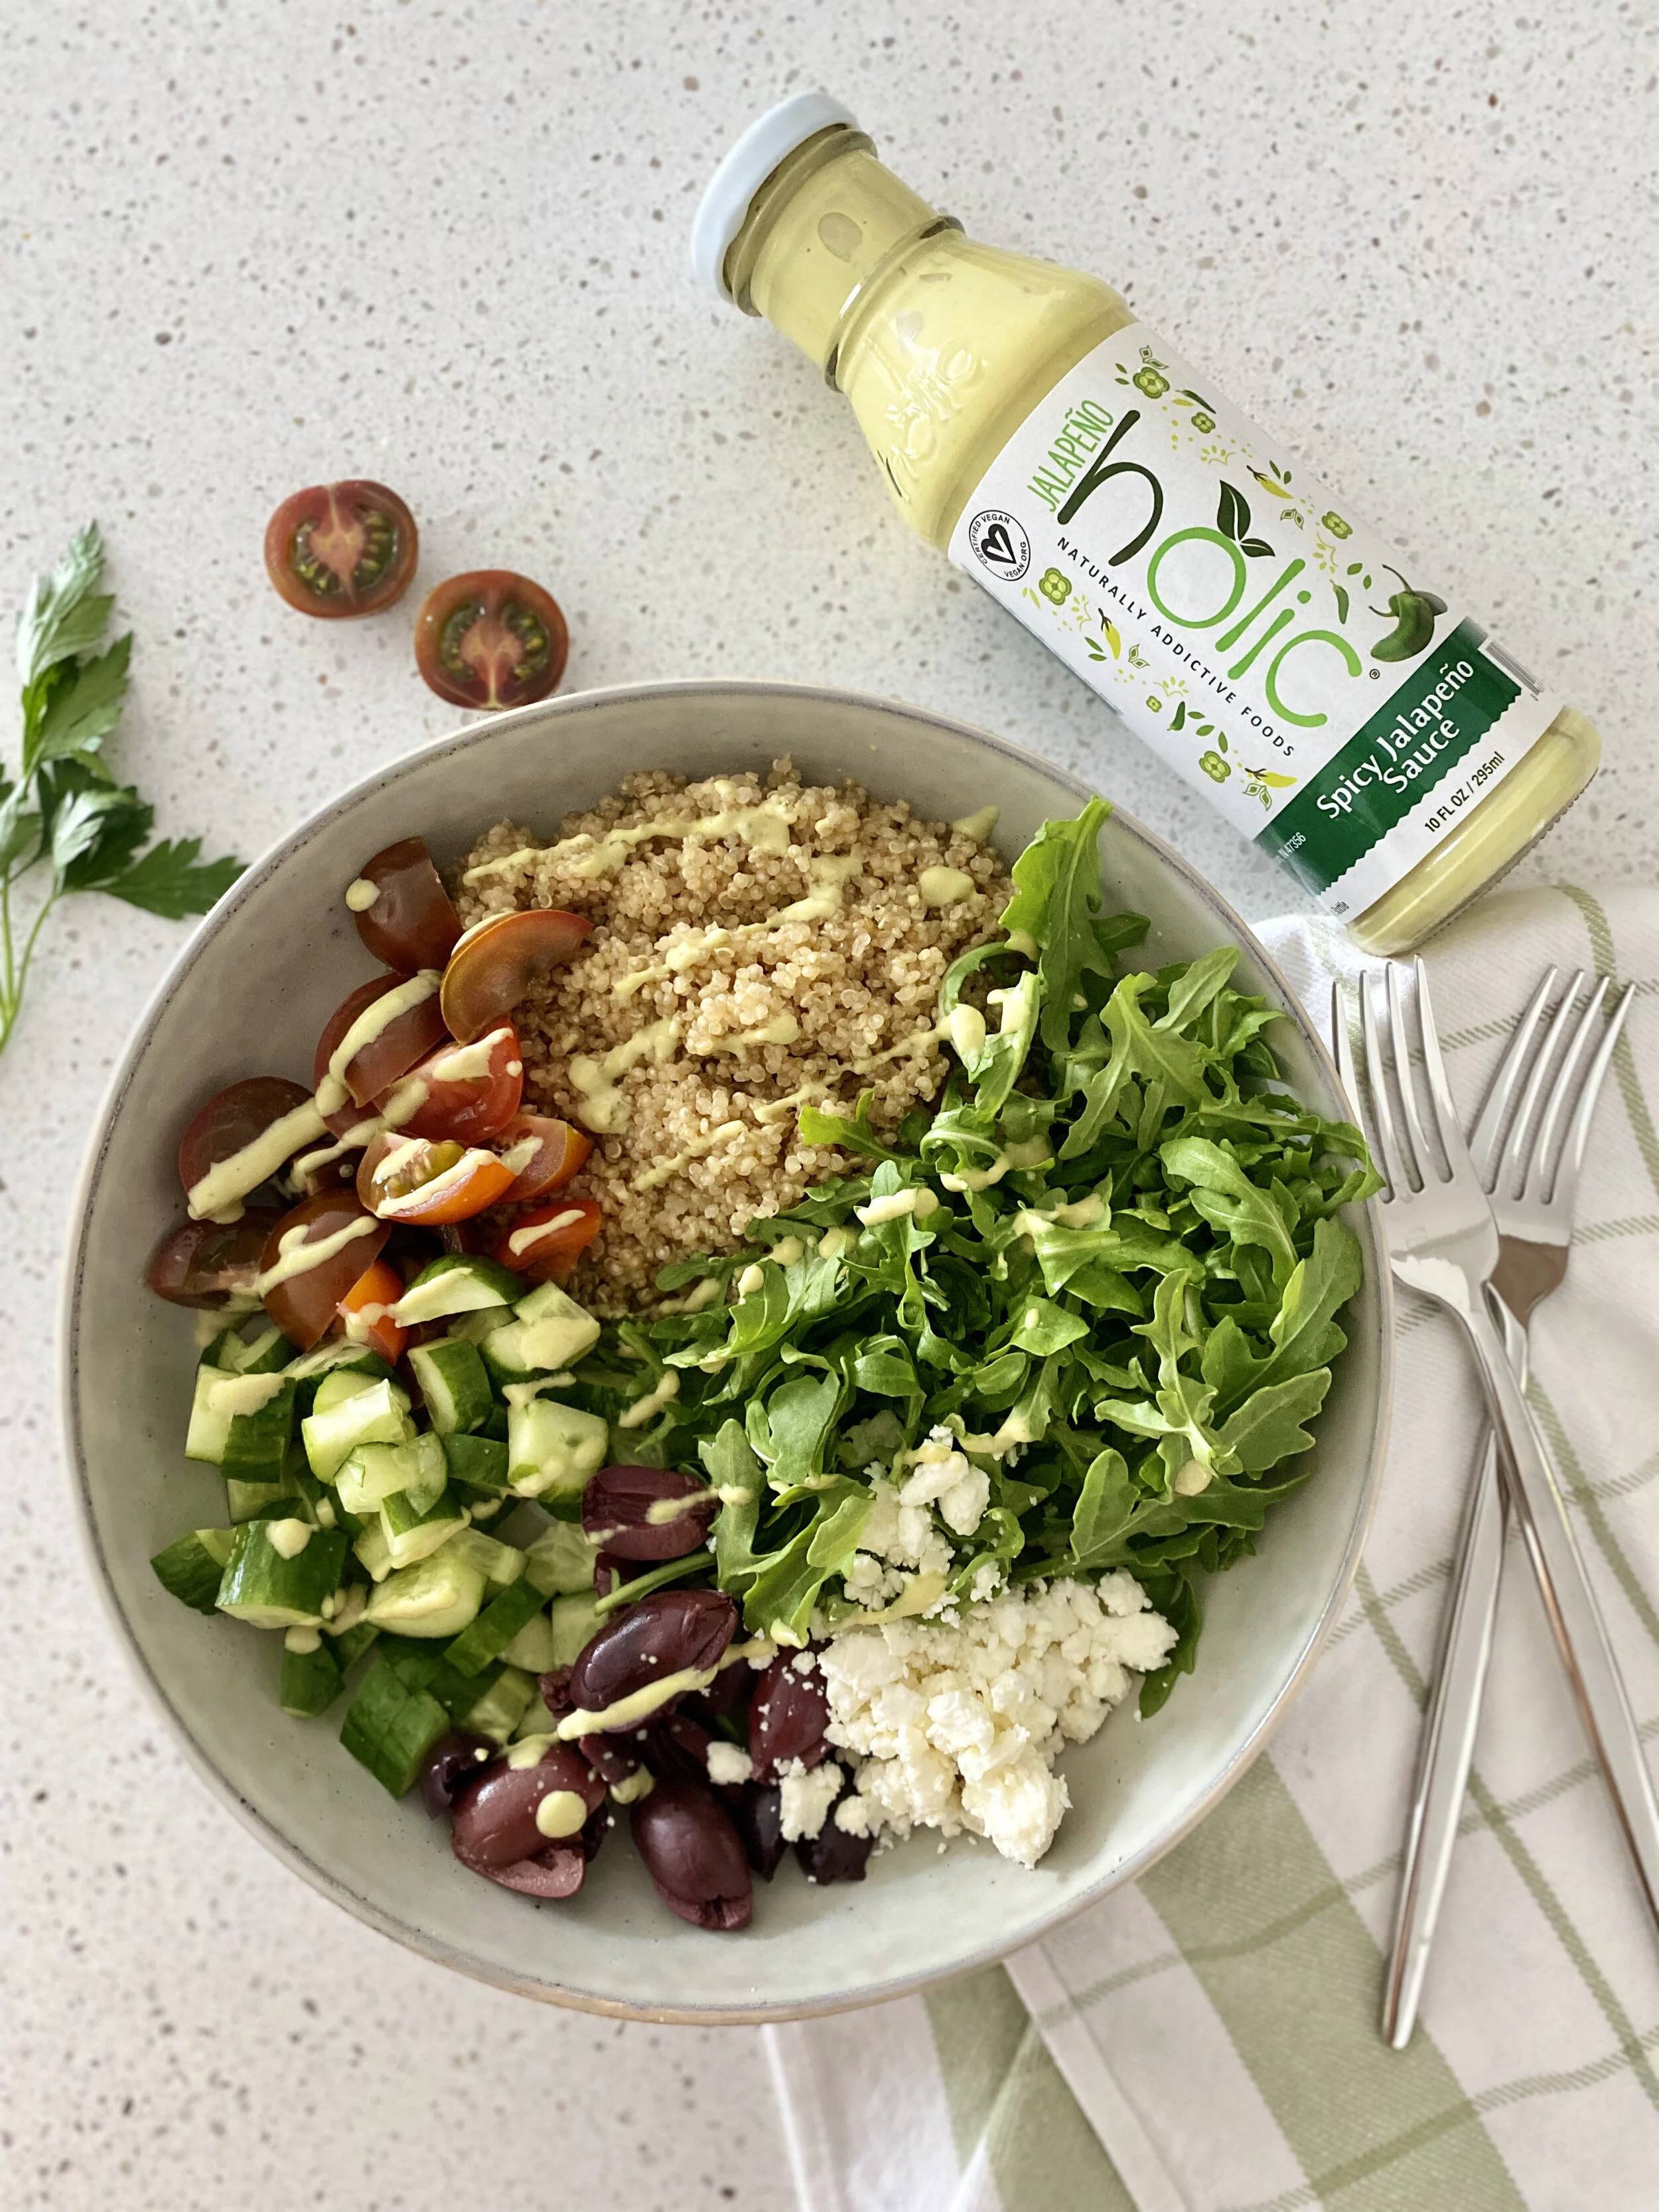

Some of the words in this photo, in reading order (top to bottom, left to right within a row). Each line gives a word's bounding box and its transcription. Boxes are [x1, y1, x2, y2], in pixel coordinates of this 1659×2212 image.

[1027, 400, 1114, 512] JALAPEÑO
[972, 520, 987, 564] CERTIFIED
[981, 514, 1010, 524] VEGAN
[1057, 409, 1362, 728] holic
[1057, 537, 1147, 620] NATURALLY
[1151, 625, 1236, 703] ADDICTIVE
[1241, 706, 1294, 756] FOODS
[1317, 755, 1383, 819] Spicy
[1376, 660, 1474, 762] Jalapeño
[1383, 719, 1460, 794] Sauce
[1424, 818, 1441, 832] 10
[1436, 806, 1455, 821] FL
[1451, 788, 1469, 806] OZ
[1466, 781, 1474, 794] /
[1471, 751, 1505, 786] 295ml
[1283, 832, 1306, 854] 47356
